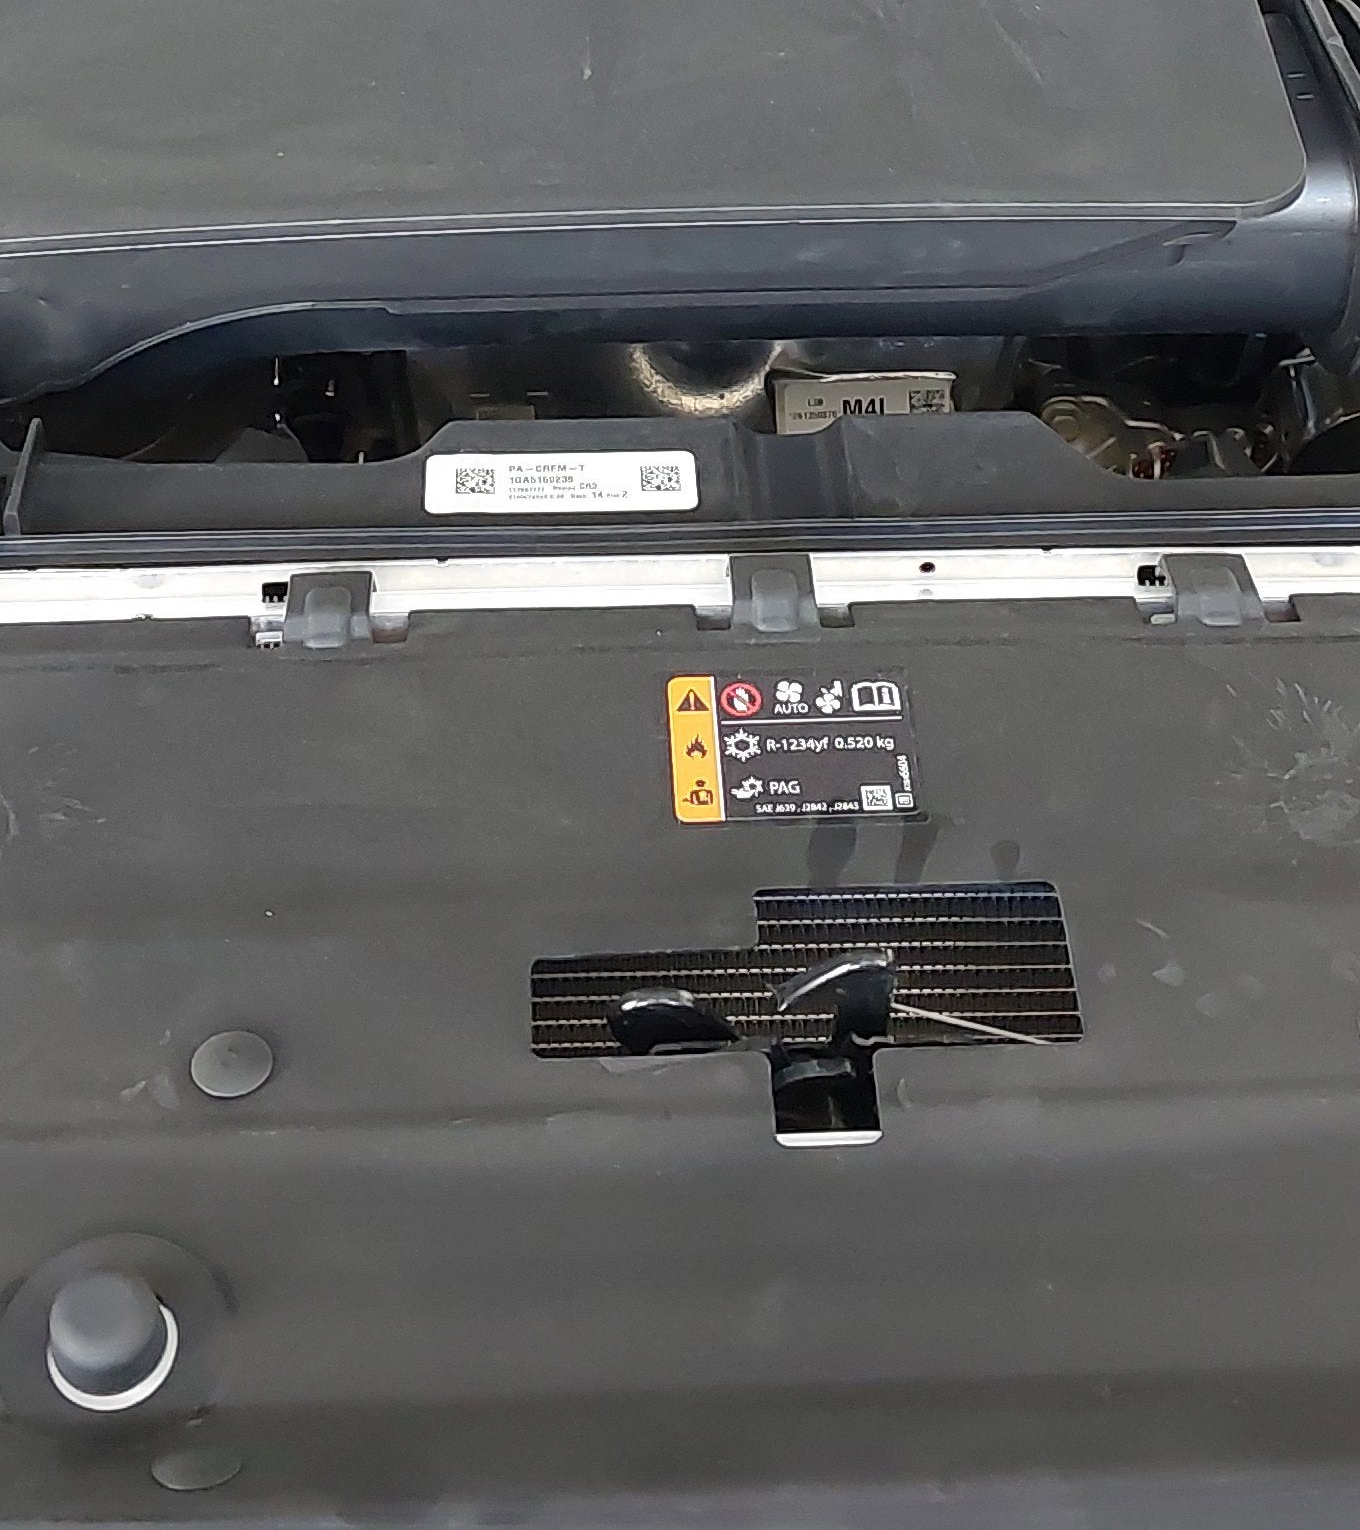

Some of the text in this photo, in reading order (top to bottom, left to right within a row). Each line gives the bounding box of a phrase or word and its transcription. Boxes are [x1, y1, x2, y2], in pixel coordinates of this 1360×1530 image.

[774, 702, 809, 714] AUTO
[766, 736, 894, 753] R-1234yf 0.520 kg
[769, 781, 800, 794] PAG
[755, 803, 774, 813] SAE
